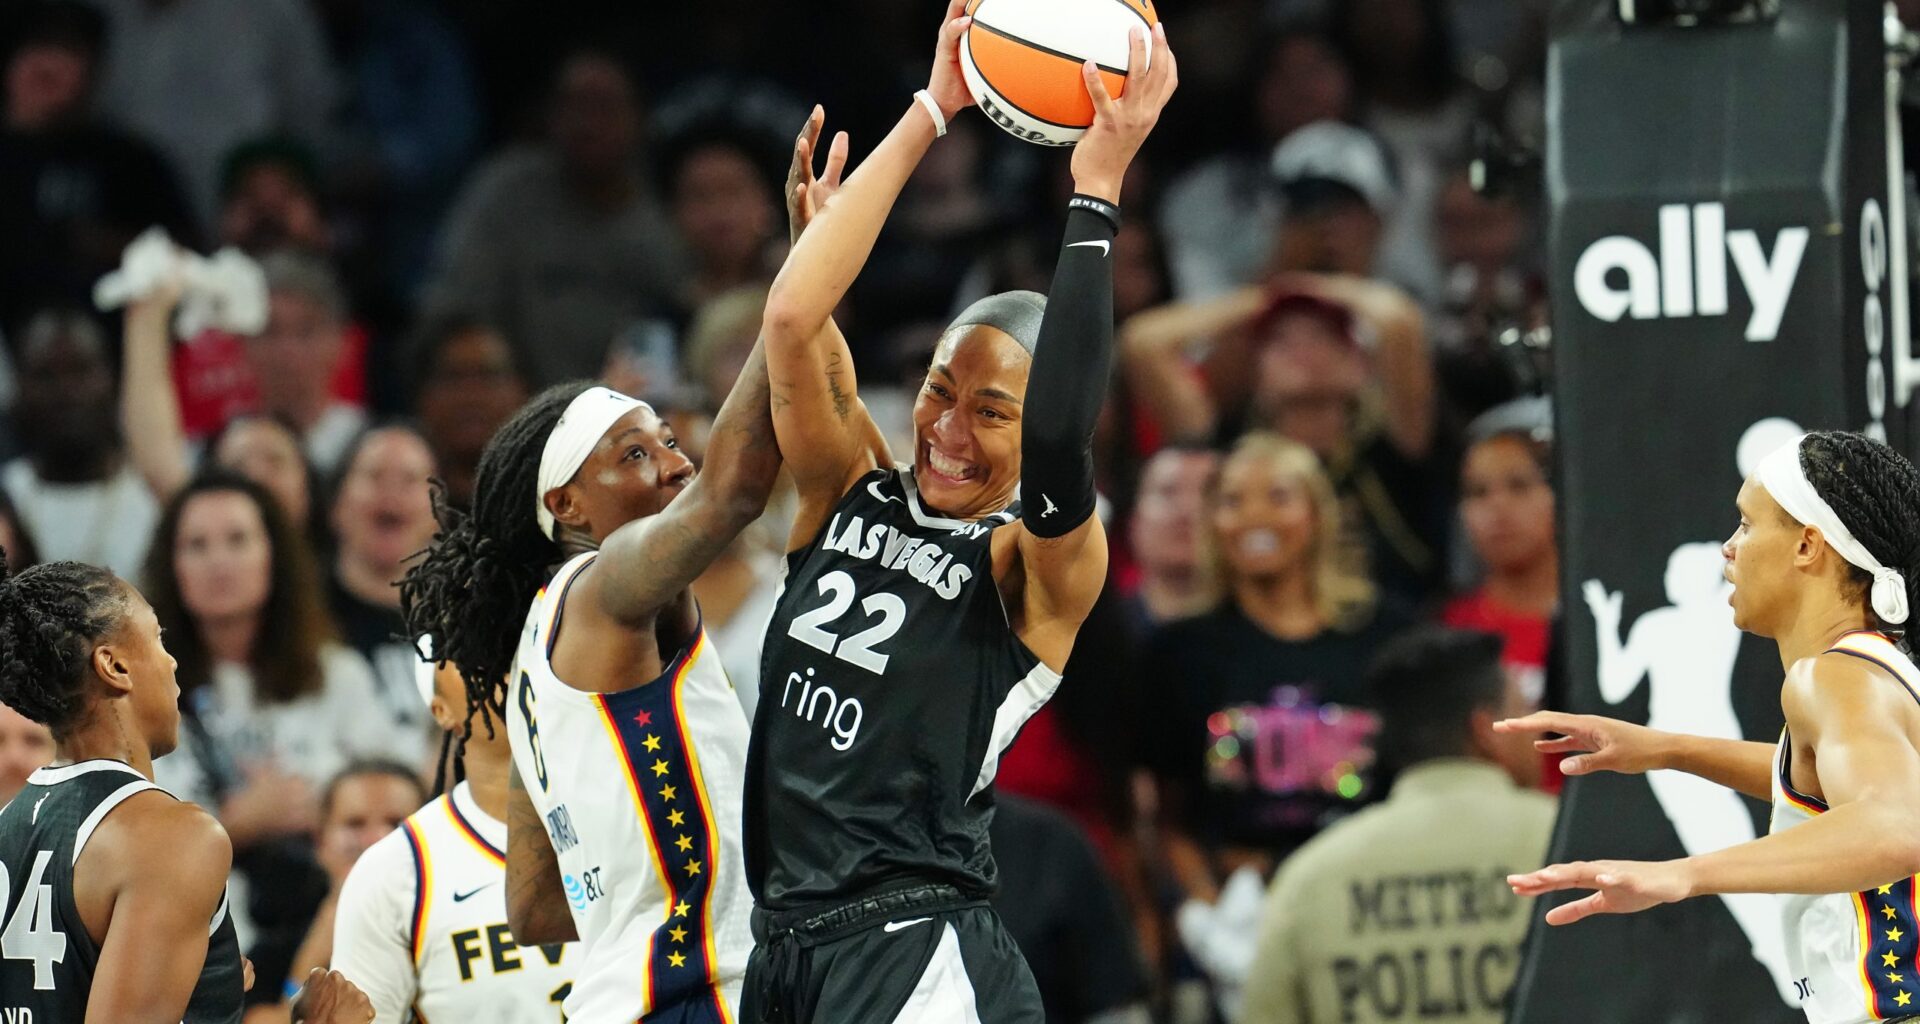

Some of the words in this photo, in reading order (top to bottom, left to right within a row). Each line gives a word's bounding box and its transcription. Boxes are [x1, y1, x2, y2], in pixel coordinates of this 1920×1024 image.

[1574, 201, 1810, 342] ally
[822, 512, 889, 560] LAS
[879, 525, 973, 600] VEGAS
[787, 570, 907, 676] 22
[781, 667, 863, 751] ring
[0, 850, 67, 990] 4
[1350, 866, 1517, 936] METRO
[1332, 944, 1518, 1024] POLIC
